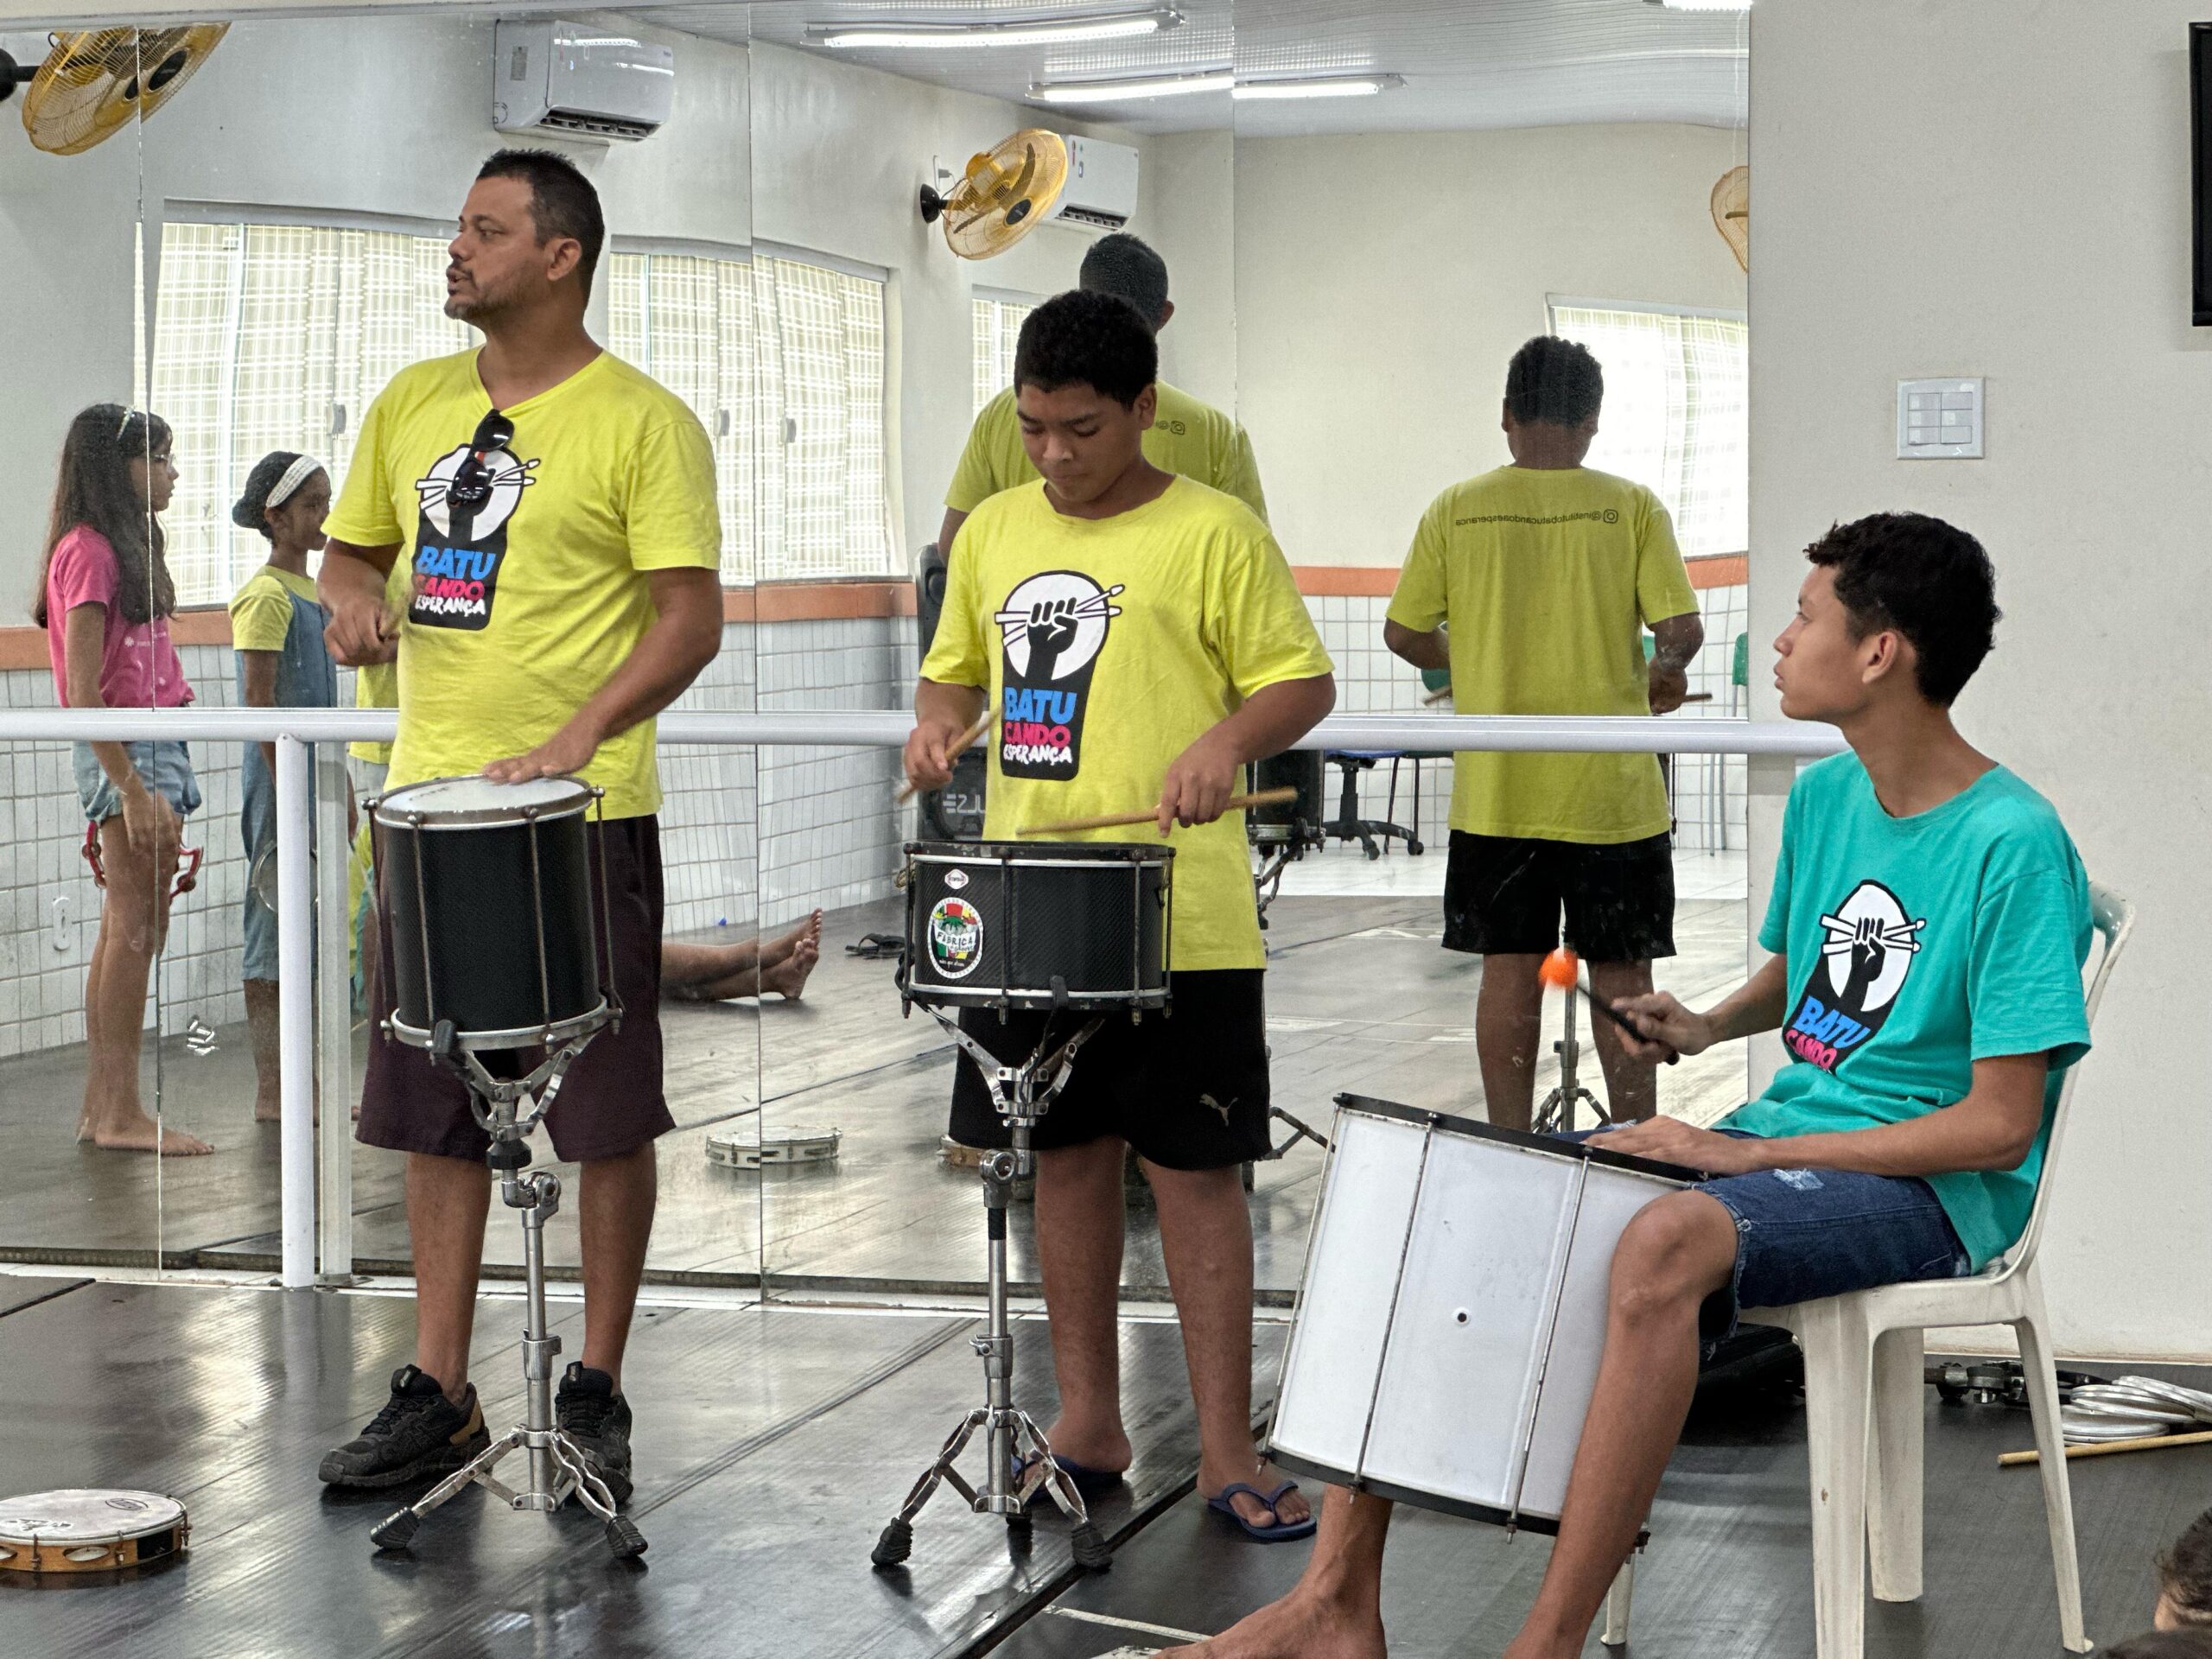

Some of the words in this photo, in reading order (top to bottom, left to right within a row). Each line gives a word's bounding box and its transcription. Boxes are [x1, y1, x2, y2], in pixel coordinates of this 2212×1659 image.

[416, 546, 496, 580] BATU
[415, 595, 486, 617] ESPERANÇA
[1004, 687, 1077, 724] BATU
[1005, 721, 1071, 748] CANDO
[1003, 744, 1072, 766] ESPERANÇA
[1791, 995, 1871, 1049] BATU
[1785, 1030, 1838, 1070] CANDO
